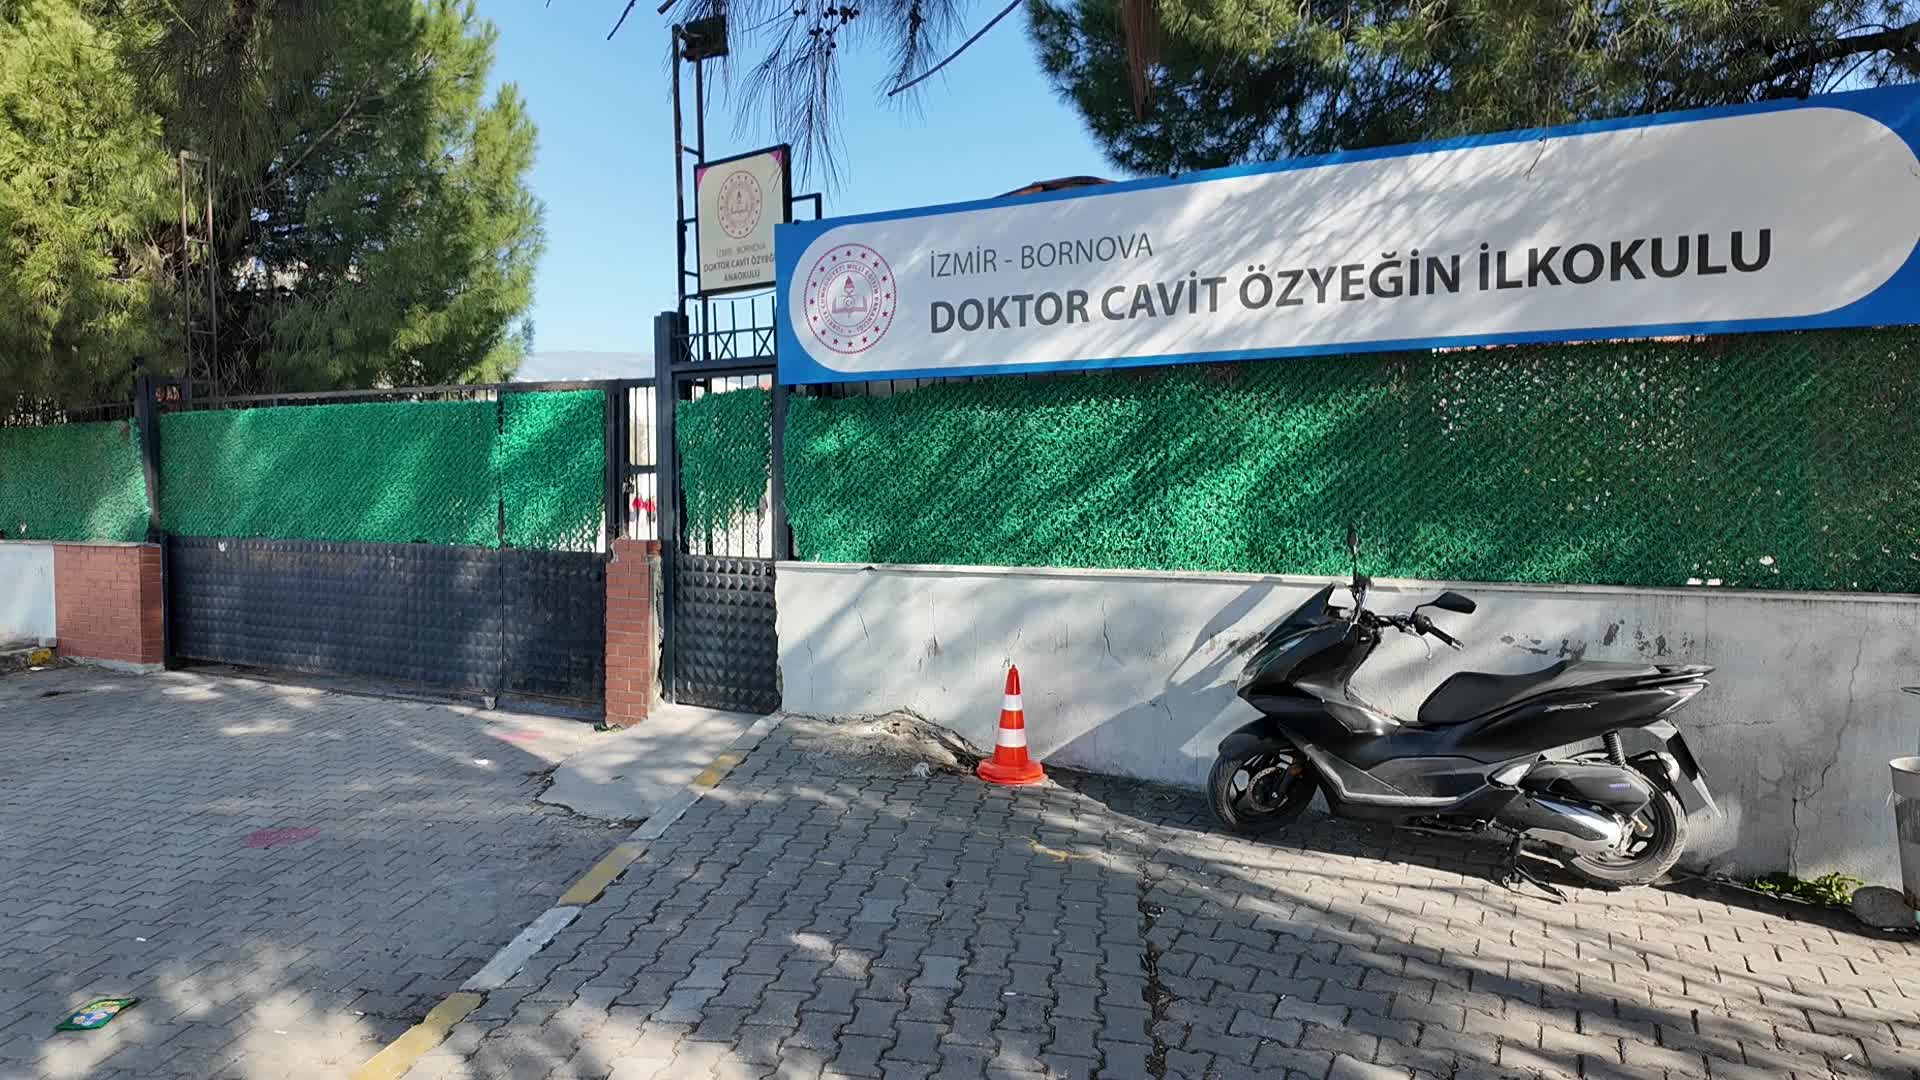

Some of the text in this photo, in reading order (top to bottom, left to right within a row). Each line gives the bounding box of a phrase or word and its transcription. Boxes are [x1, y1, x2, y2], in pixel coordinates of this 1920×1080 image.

[724, 270, 761, 281] ANAOKULU
[930, 245, 997, 278] İZMİR
[1021, 232, 1153, 270] BORNOVA
[930, 228, 1772, 334] DOKTOR CAVİT ÖZYEĞİN İLKOKULU
